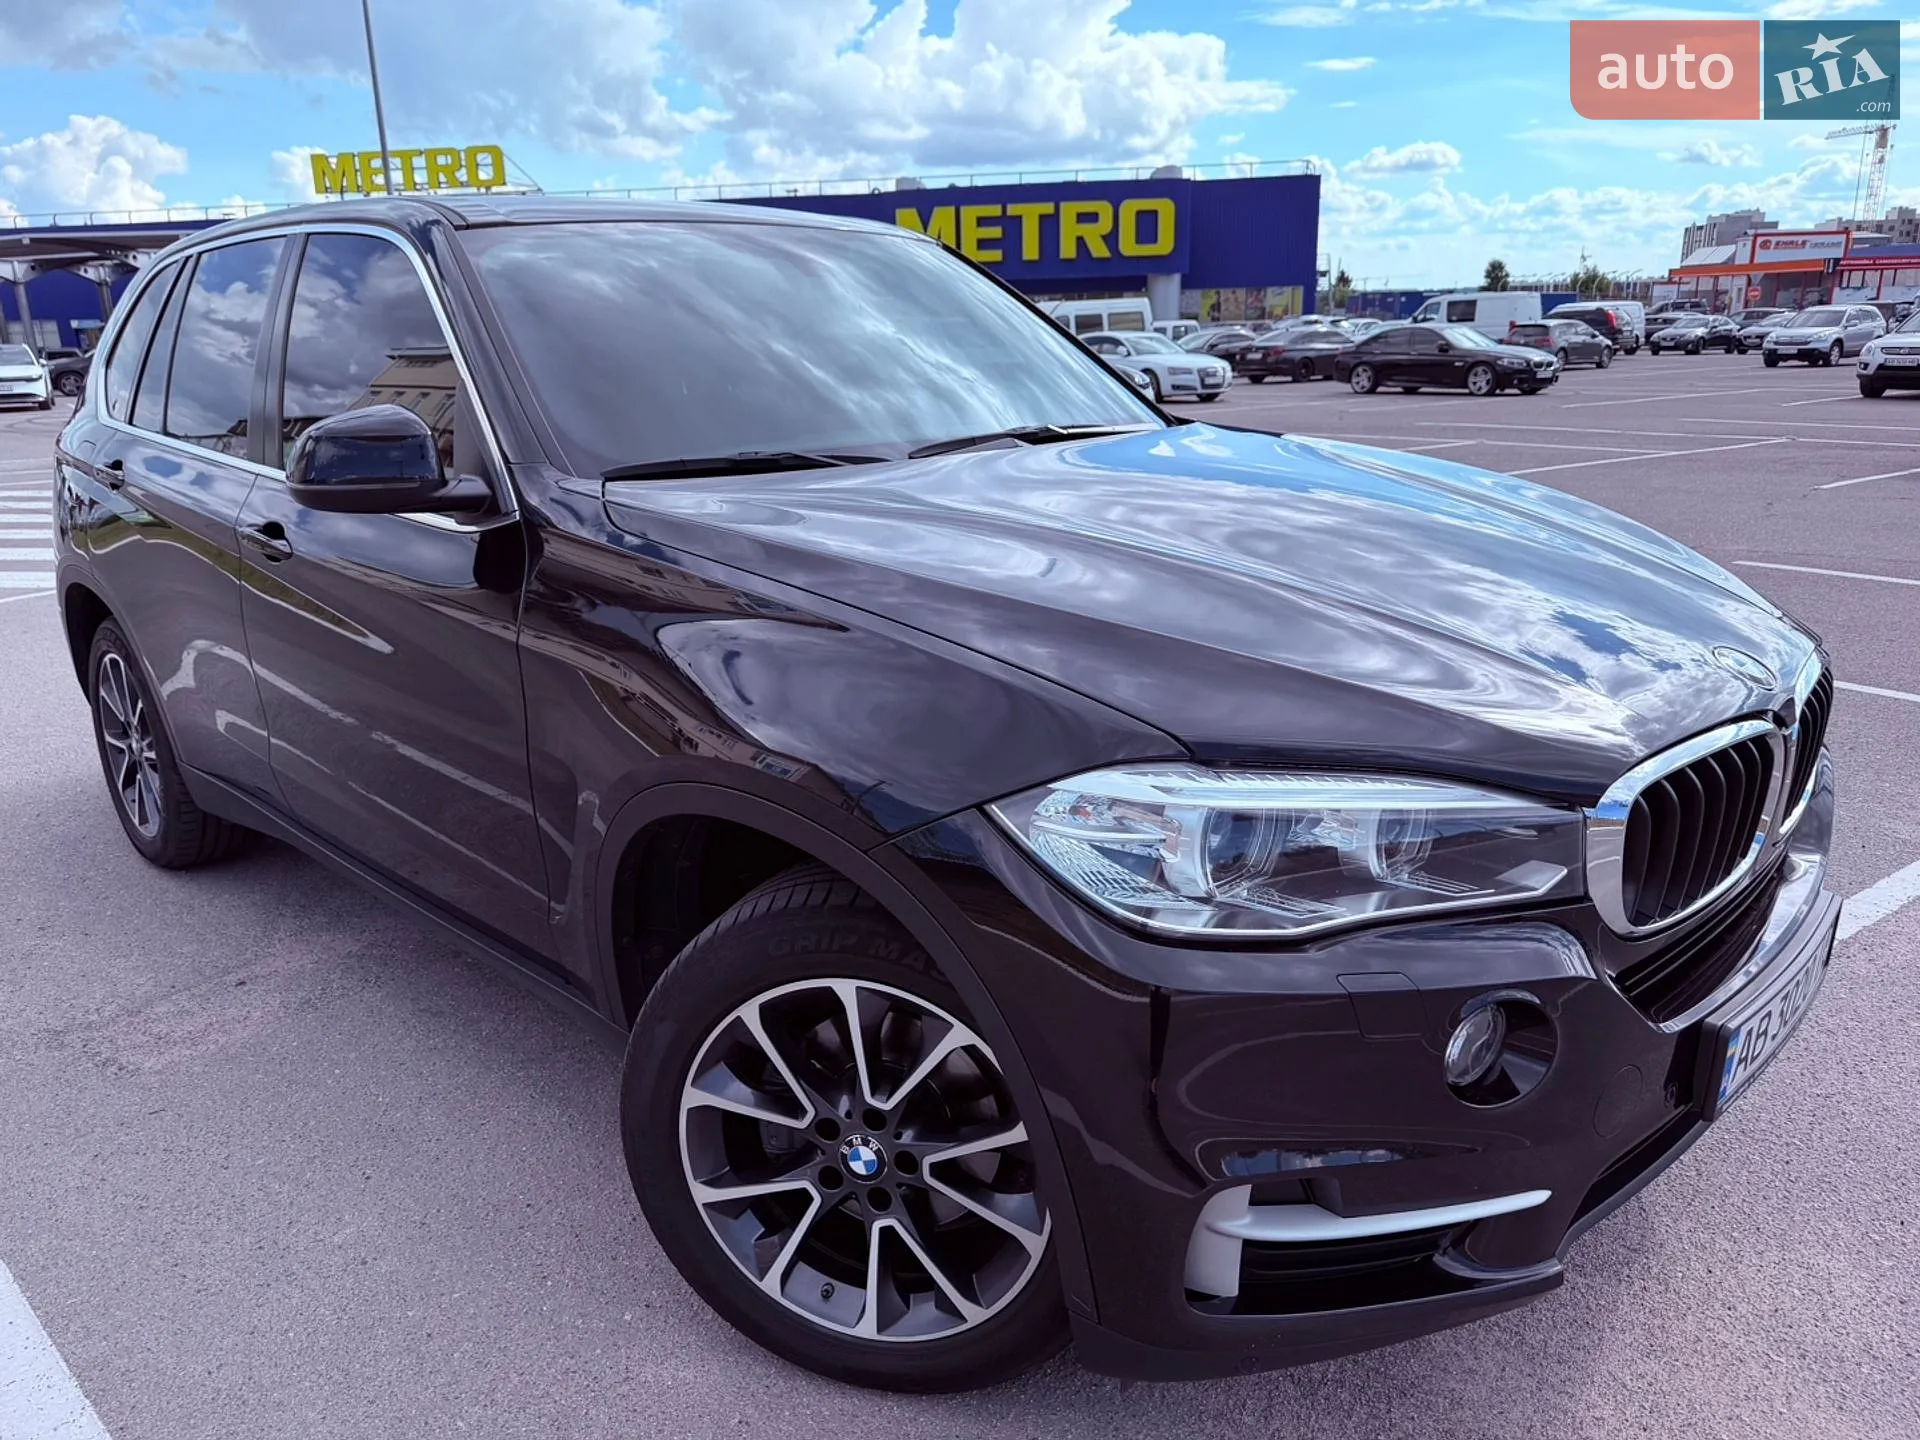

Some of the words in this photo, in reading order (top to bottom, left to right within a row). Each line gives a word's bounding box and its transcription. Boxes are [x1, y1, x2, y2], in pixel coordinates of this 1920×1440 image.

[311, 145, 506, 194] METRO
[895, 198, 1176, 263] METRO
[771, 930, 859, 956] GRIP
[1731, 1009, 1772, 1084] AB
[840, 1136, 879, 1155] BMW
